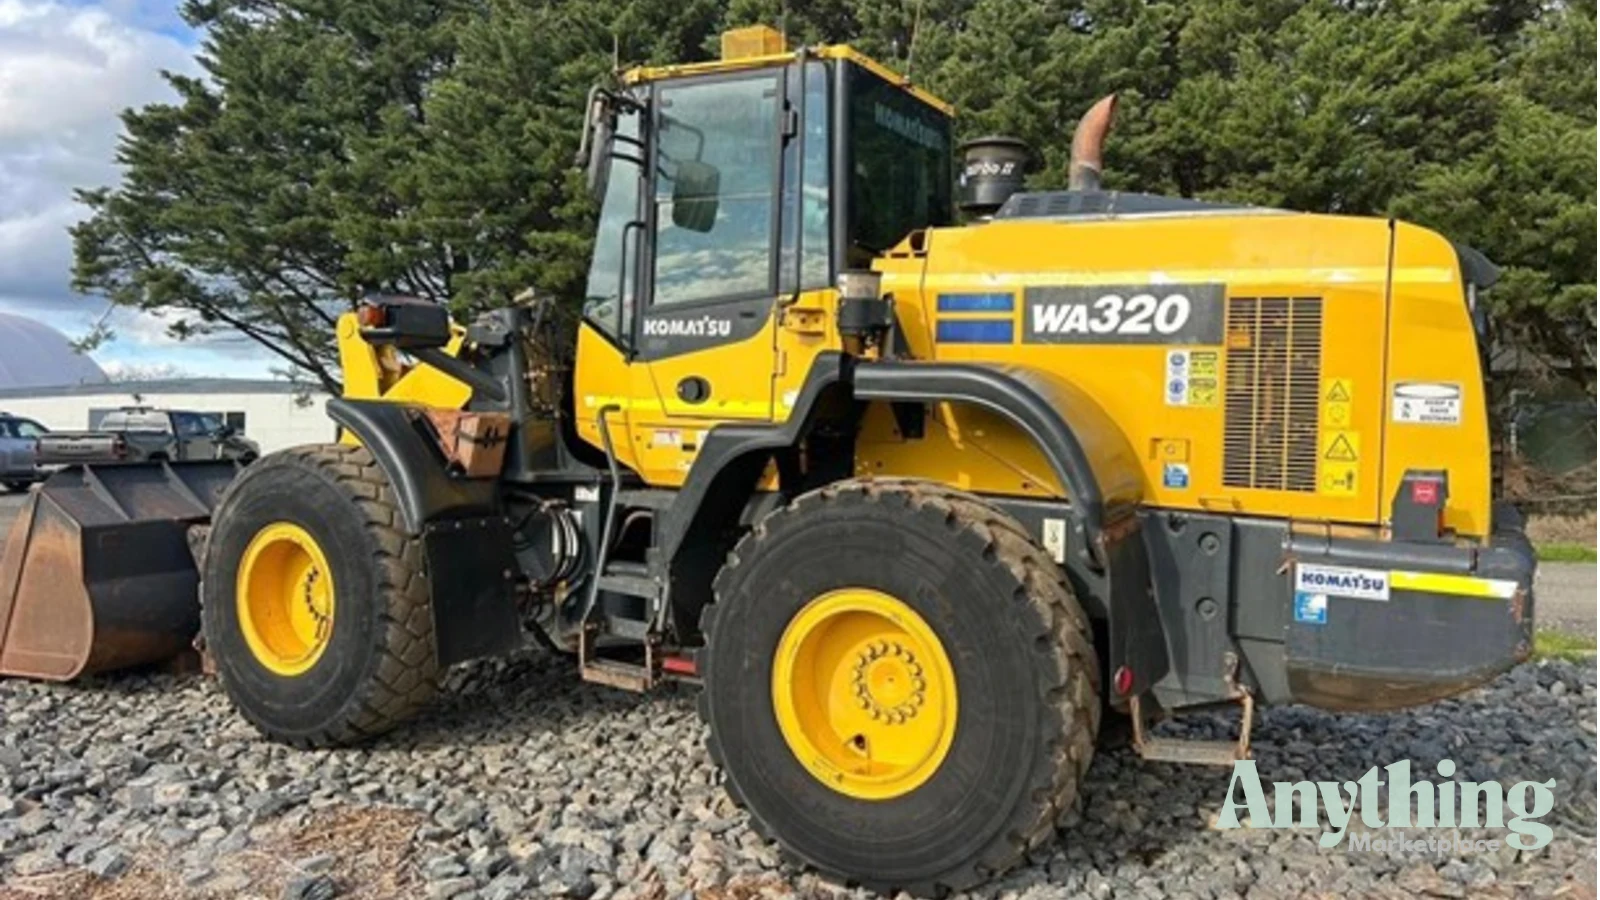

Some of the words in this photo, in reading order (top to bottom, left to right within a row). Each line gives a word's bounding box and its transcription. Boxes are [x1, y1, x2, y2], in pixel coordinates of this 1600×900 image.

[1033, 294, 1191, 334] WA320
[643, 315, 731, 336] KOMATSU
[1302, 573, 1384, 591] KOMATSU
